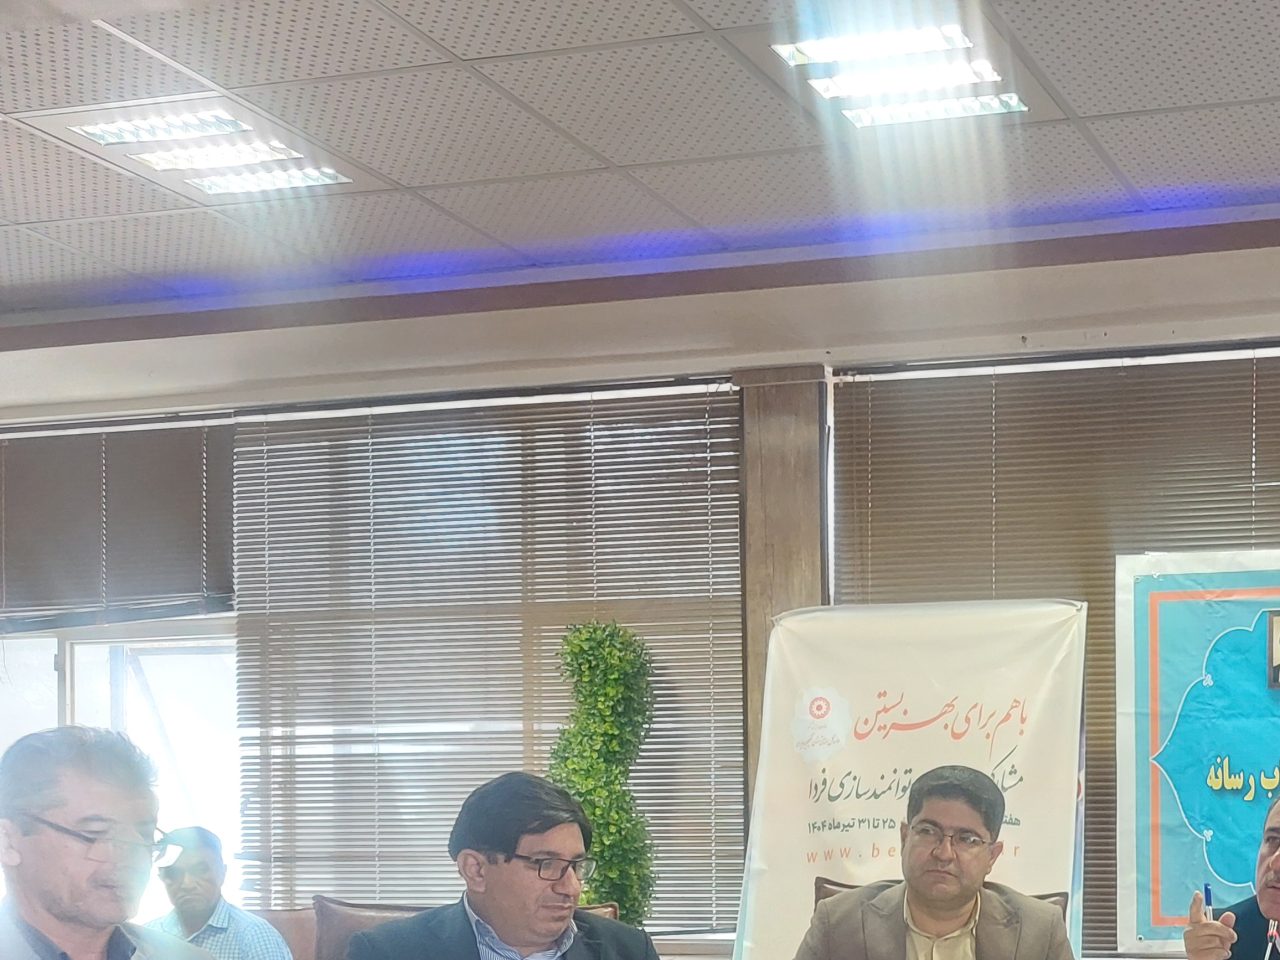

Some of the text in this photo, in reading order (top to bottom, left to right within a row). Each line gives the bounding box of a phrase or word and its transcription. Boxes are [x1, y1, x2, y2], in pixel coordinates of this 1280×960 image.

[950, 702, 996, 740] برای
[808, 767, 828, 803] فردا
[1205, 755, 1256, 801] رسانه
[857, 818, 871, 830] ۳۱
[872, 817, 881, 830] تا
[881, 817, 897, 830] ۲۵
